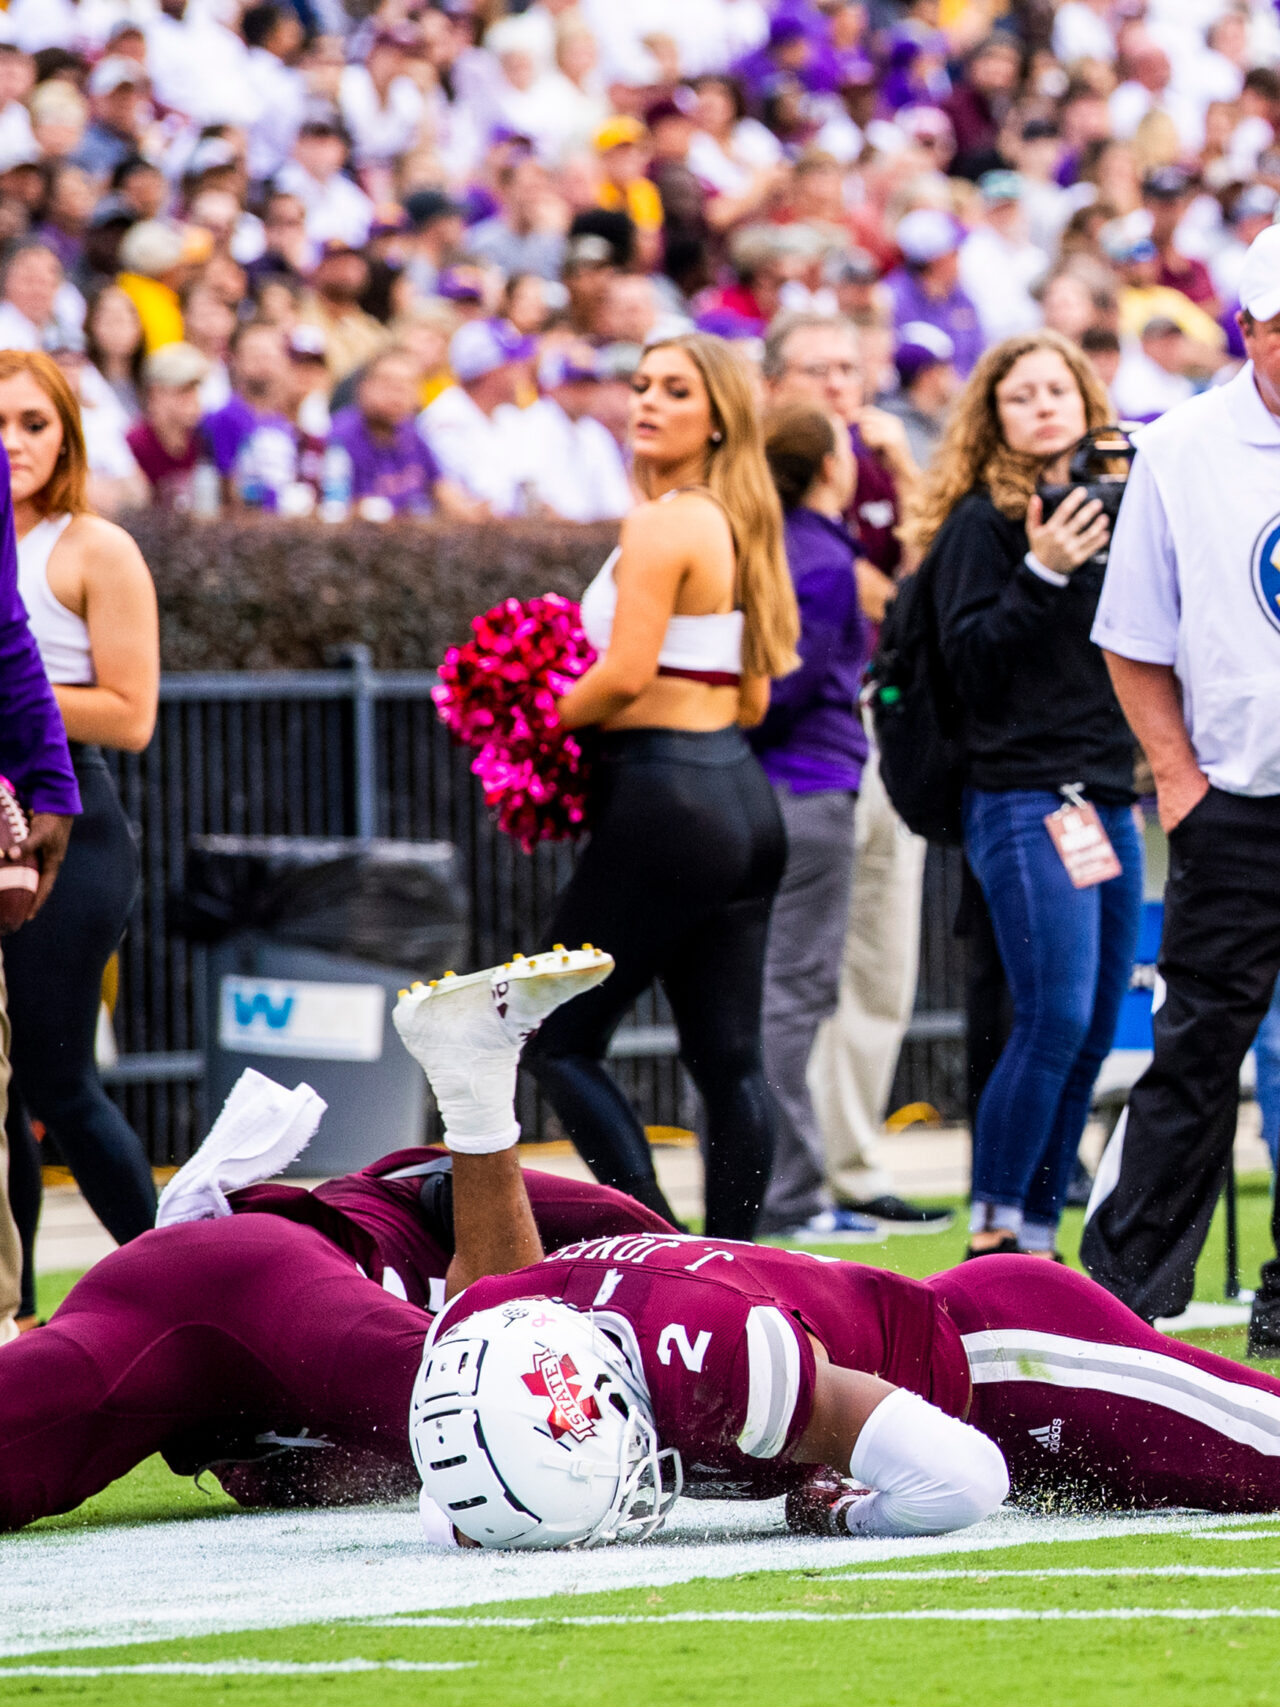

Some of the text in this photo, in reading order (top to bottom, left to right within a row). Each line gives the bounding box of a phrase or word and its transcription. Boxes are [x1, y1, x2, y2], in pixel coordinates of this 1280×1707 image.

[684, 1247, 735, 1271] J.
[656, 1322, 713, 1374] 2
[545, 1360, 585, 1425] STATE
[1049, 1418, 1063, 1454] adidas
